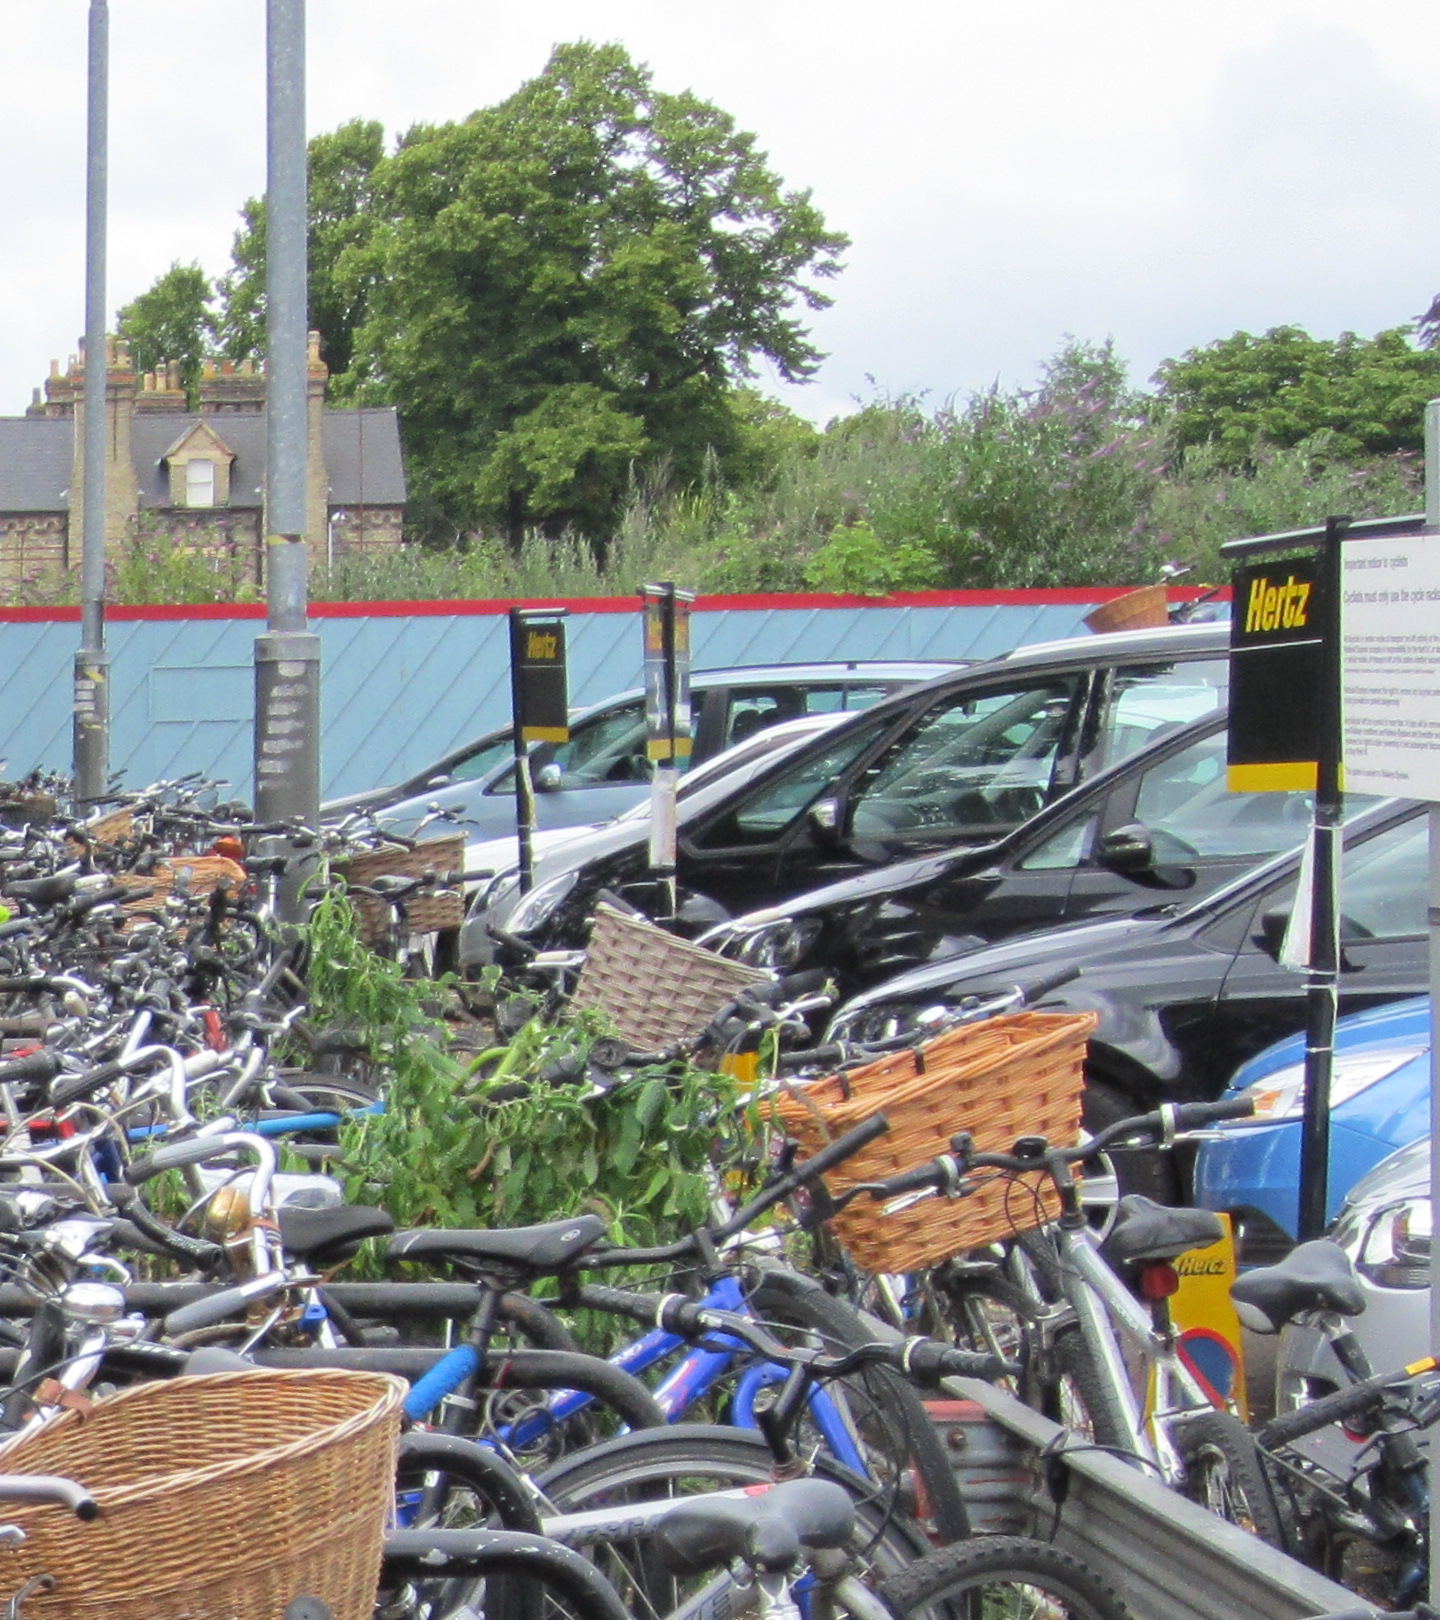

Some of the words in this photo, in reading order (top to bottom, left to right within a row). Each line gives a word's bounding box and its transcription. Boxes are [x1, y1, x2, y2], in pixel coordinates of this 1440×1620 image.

[1245, 575, 1311, 633] Hertz
[527, 631, 558, 659] Hertz
[1178, 1256, 1226, 1276] Hertz
